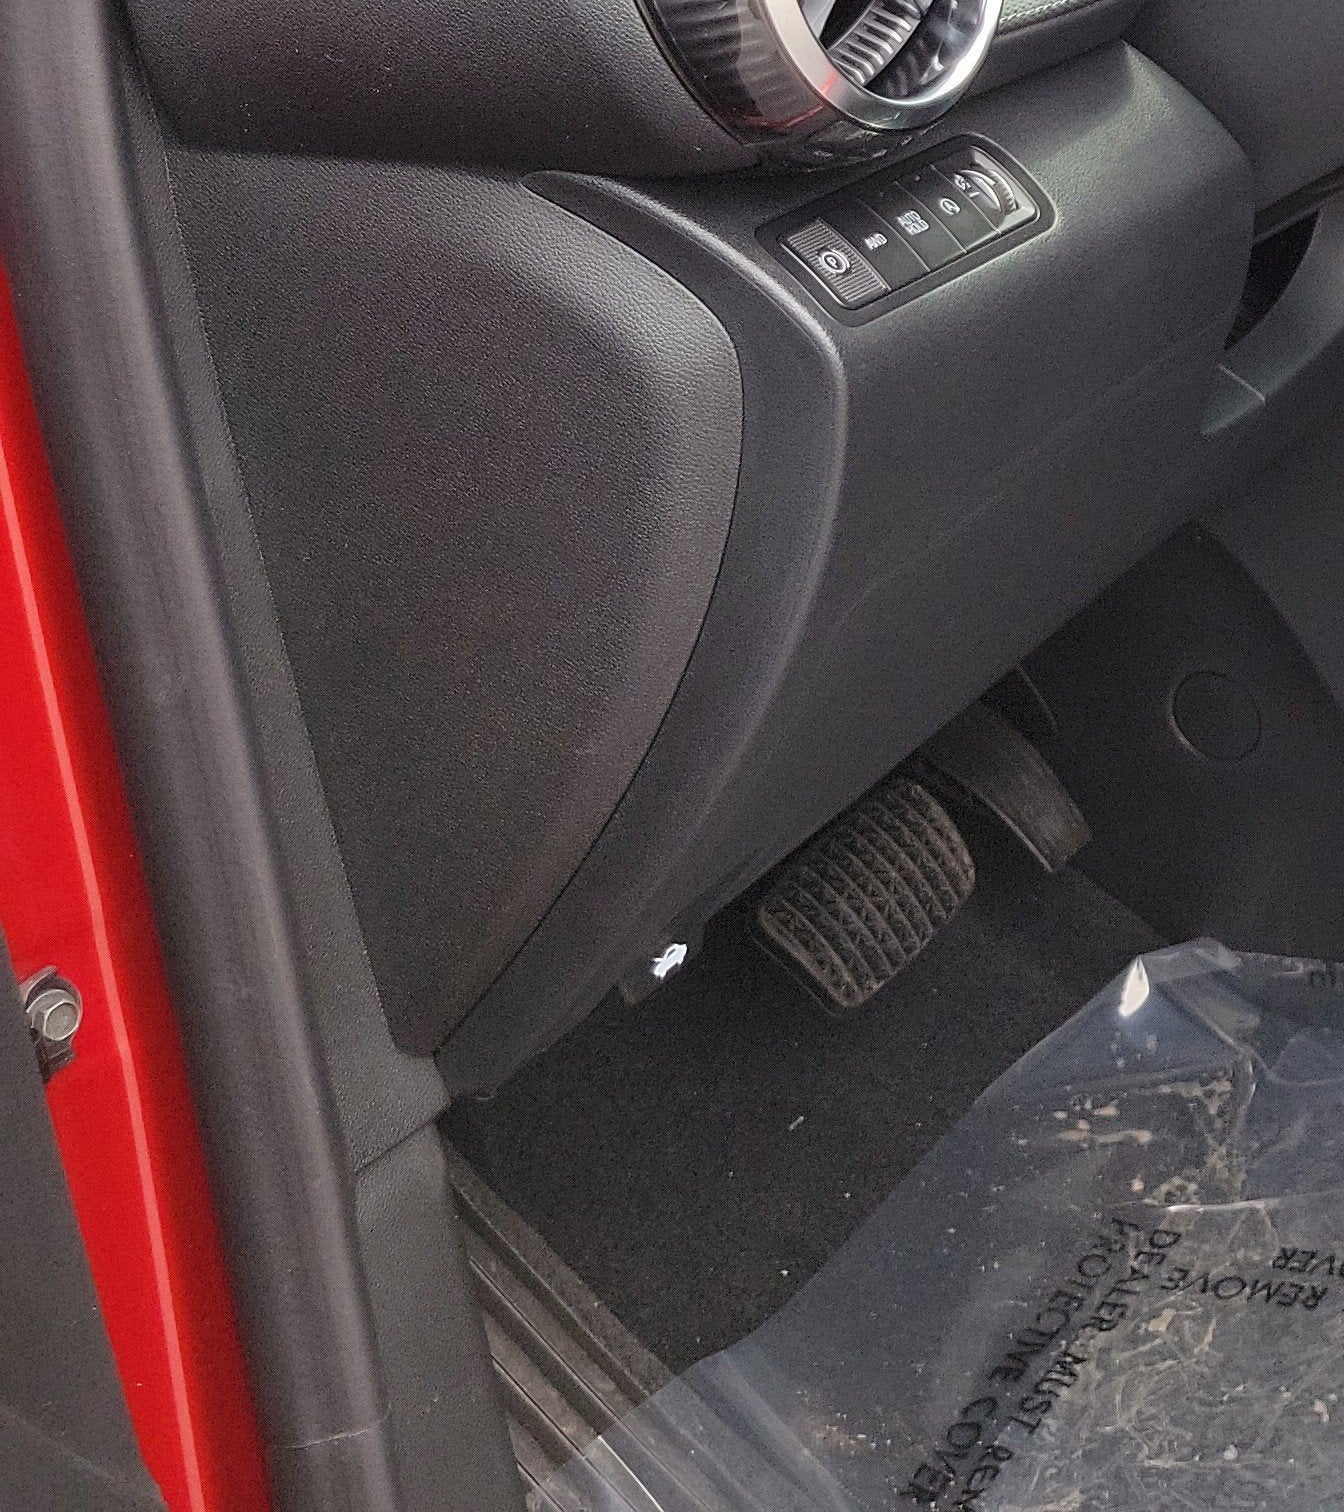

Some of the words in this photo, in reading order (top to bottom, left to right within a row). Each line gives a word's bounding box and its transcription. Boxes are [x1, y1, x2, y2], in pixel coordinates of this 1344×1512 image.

[863, 233, 888, 250] AWD
[1082, 1228, 1182, 1332] DEALER
[1160, 1267, 1328, 1310] REMOVE
[1007, 1349, 1088, 1435] MUST
